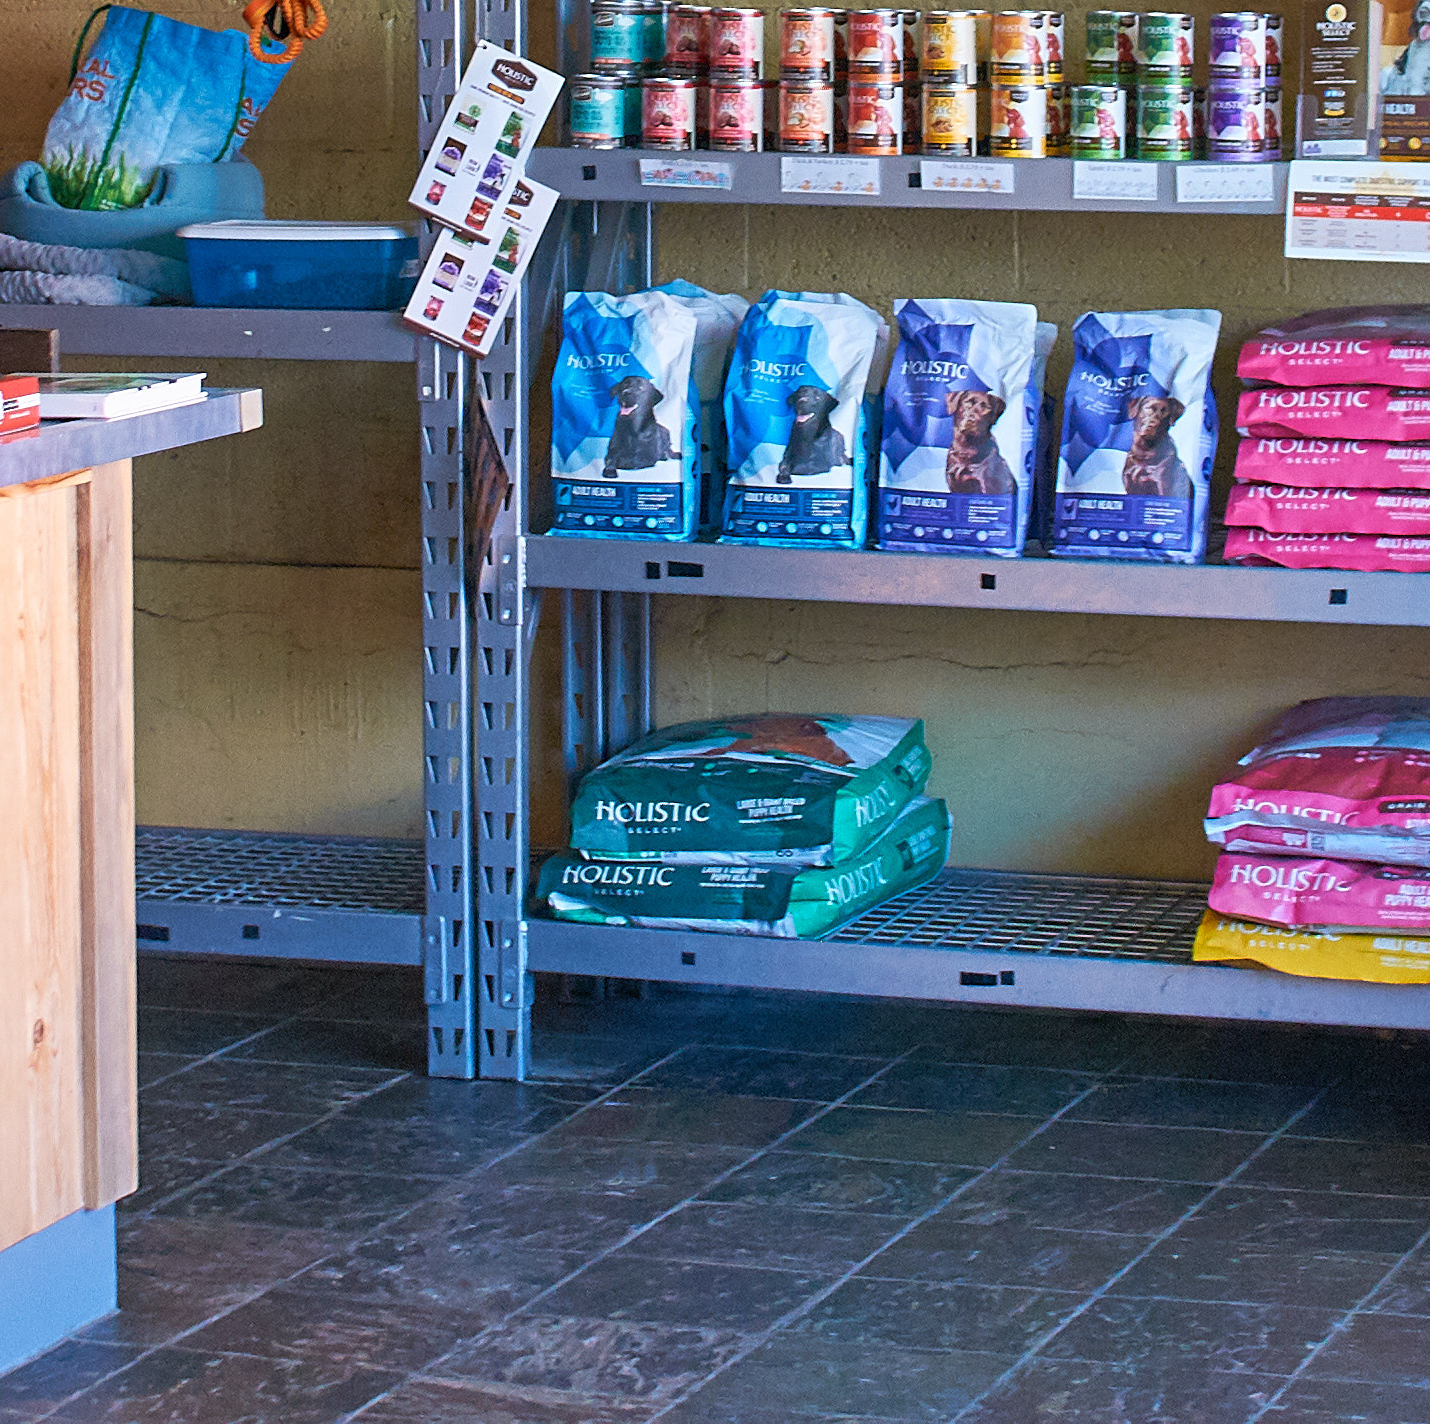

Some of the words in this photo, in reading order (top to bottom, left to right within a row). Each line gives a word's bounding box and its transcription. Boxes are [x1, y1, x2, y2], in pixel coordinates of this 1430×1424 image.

[1260, 340, 1372, 356] HOLISTIC
[748, 358, 807, 376] OLISTIC
[900, 360, 969, 379] HOLISTIC
[1080, 371, 1151, 390] HOLISTIC
[1258, 391, 1370, 408] HOLISTIC
[1257, 439, 1368, 454] HOLISTIC
[1248, 486, 1358, 501] HOLISTIC
[595, 800, 711, 823] HOLISTIC
[562, 864, 676, 887] HOLISTIC
[1230, 864, 1353, 893] HOLISTIC
